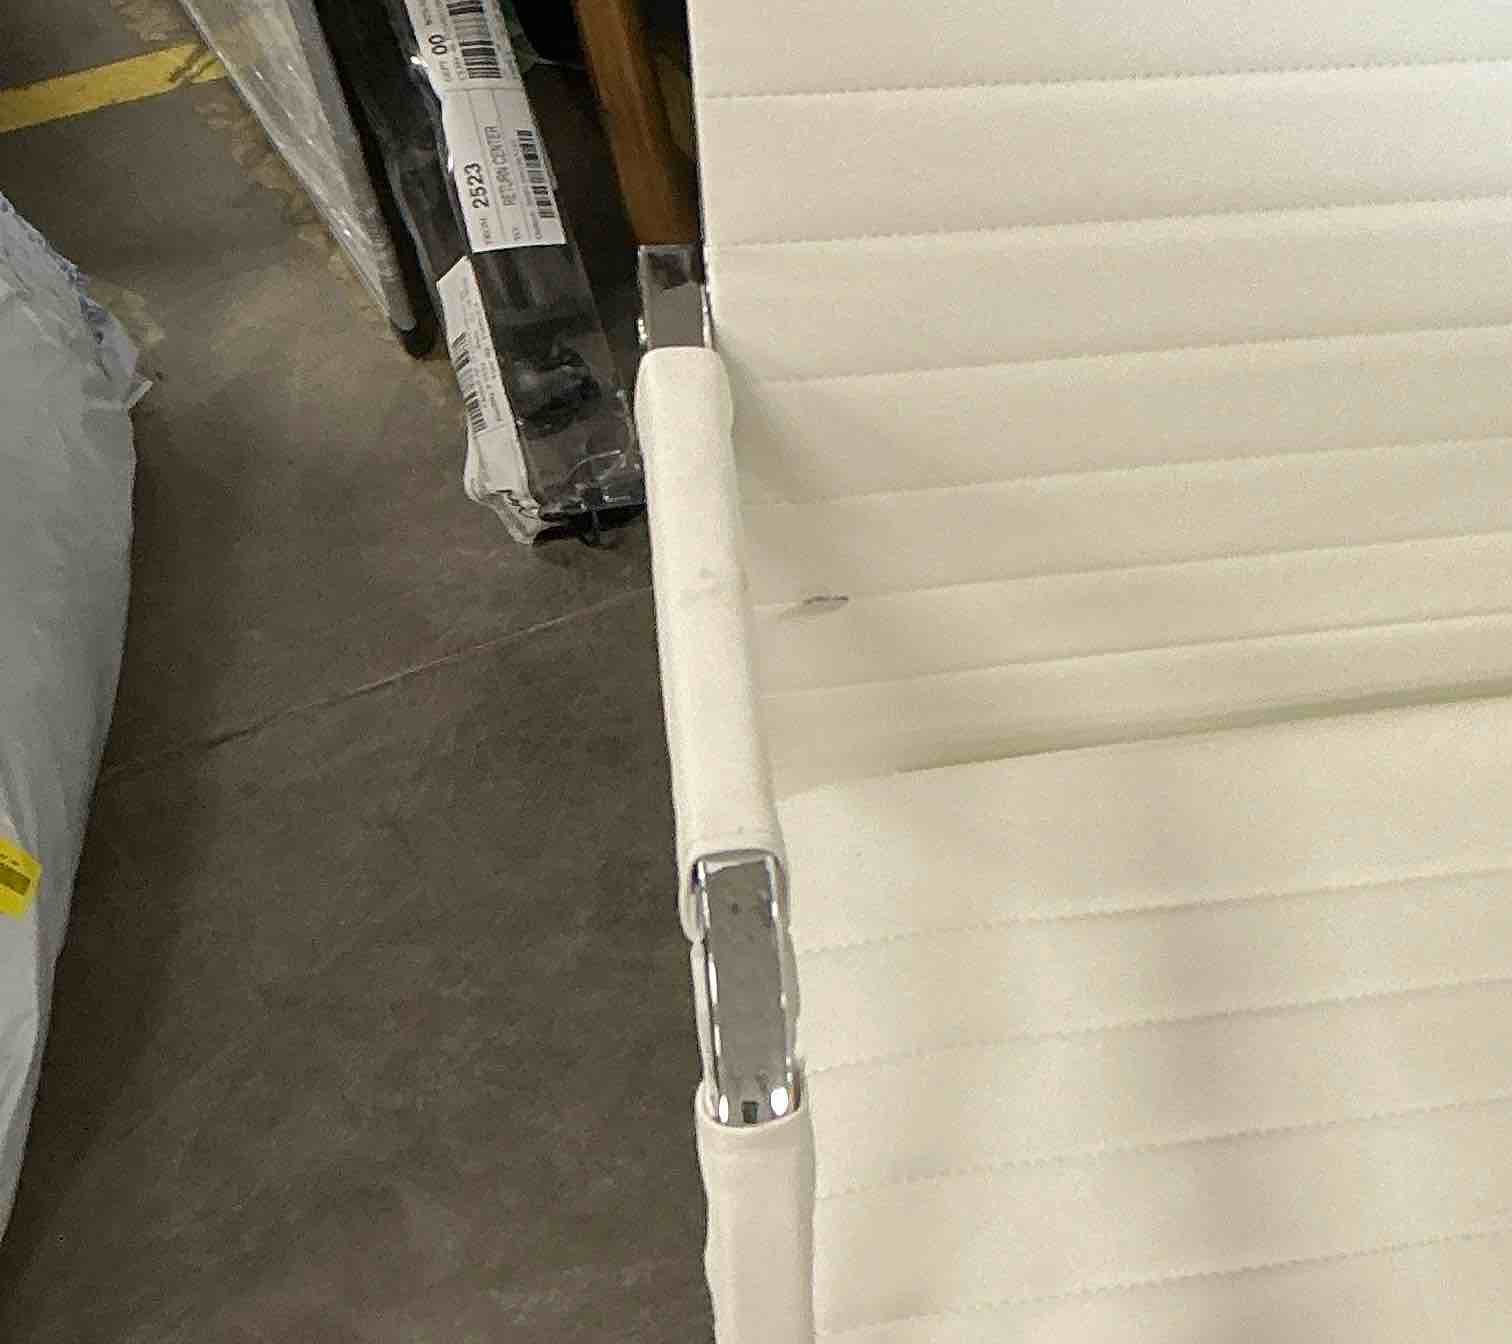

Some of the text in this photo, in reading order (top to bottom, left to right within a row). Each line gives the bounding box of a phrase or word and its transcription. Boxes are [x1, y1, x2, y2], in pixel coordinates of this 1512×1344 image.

[428, 34, 448, 55] 00
[463, 161, 490, 209] 2523
[484, 125, 518, 207] RETURN CENTER
